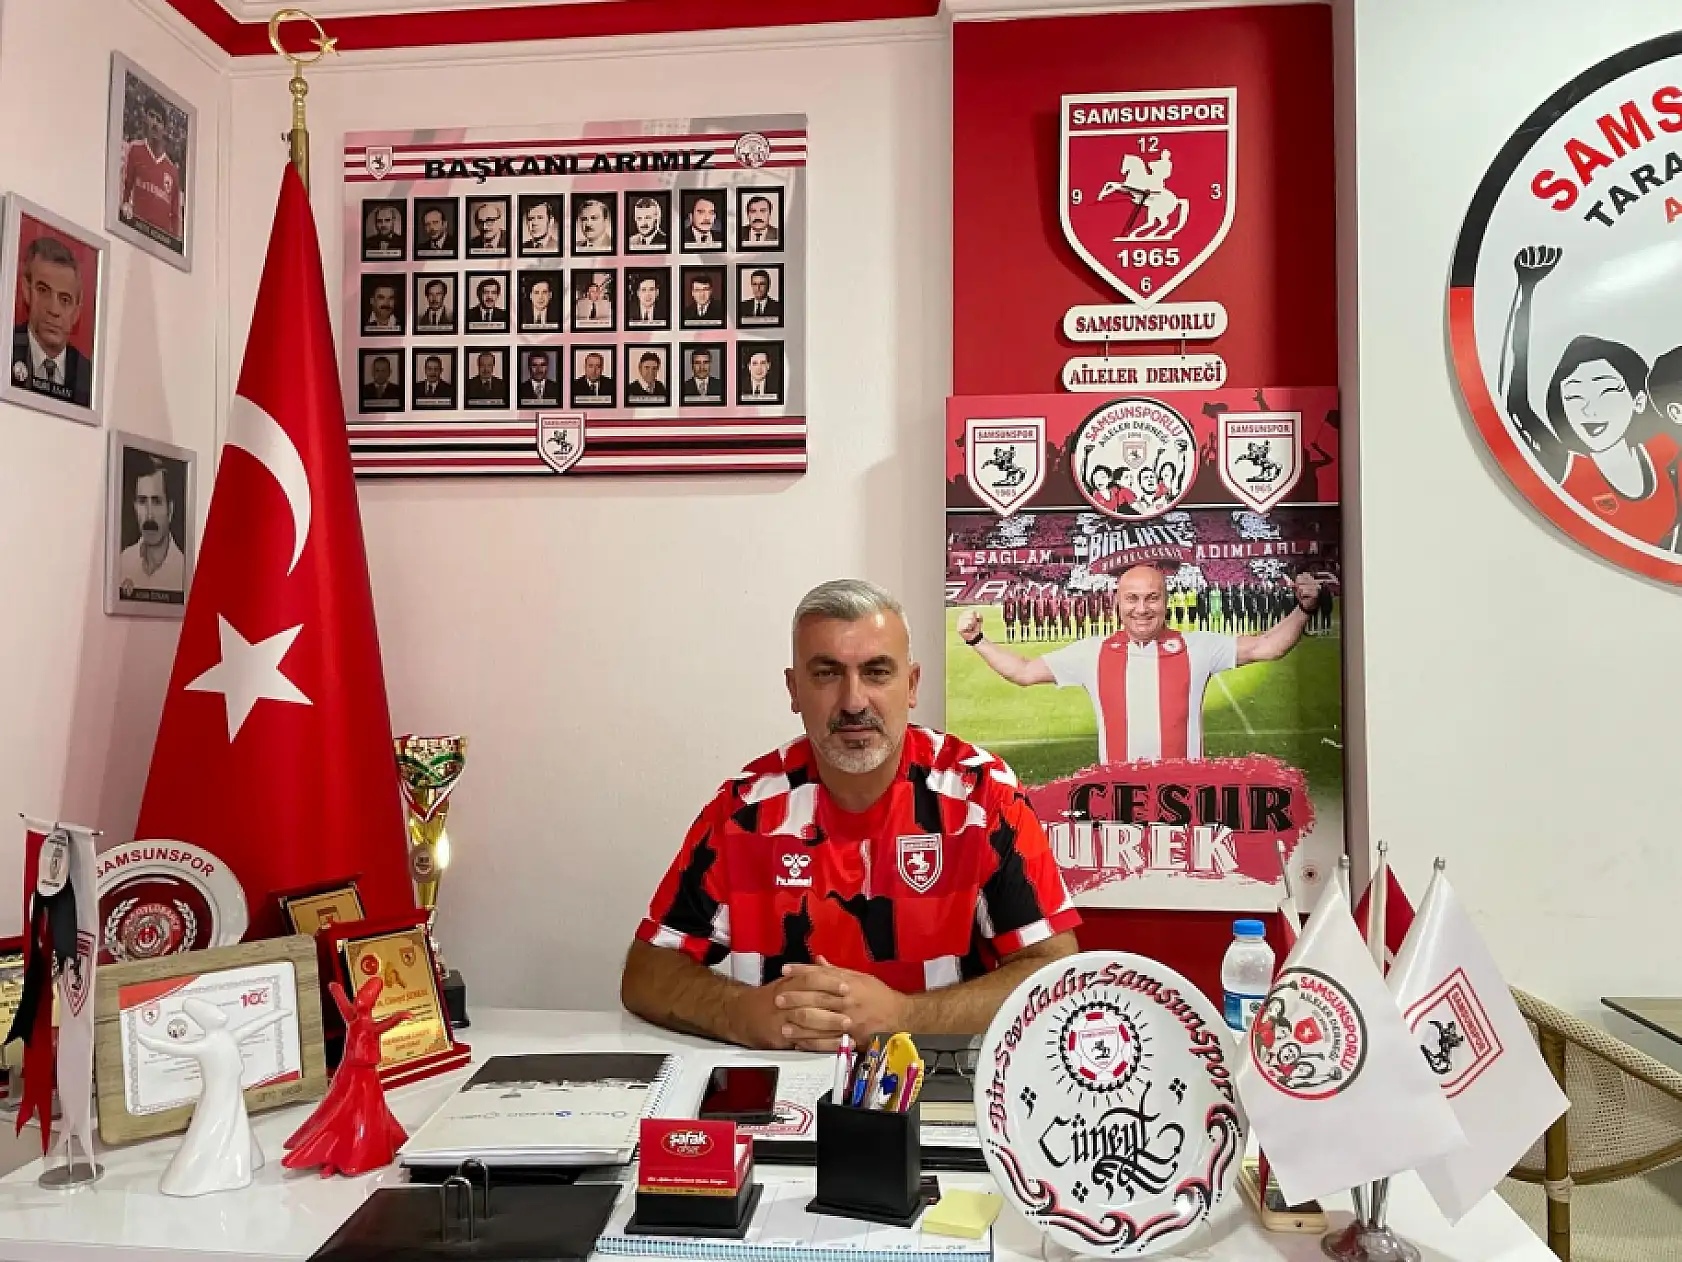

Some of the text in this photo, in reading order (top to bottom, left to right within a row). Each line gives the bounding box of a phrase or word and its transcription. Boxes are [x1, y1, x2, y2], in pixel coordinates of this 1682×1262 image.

[1072, 103, 1225, 125] SAMSUNSPOR
[1137, 136, 1159, 153] 12
[424, 150, 715, 184] BAŞKANLARIMIZ
[1071, 189, 1083, 205] 9
[1210, 183, 1222, 199] 3
[1116, 248, 1181, 268] 1965
[1139, 277, 1151, 293] 6
[1075, 312, 1217, 334] SAMSUNSPORLU
[1069, 360, 1223, 385] AİLELER DERNEĞİ
[1068, 782, 1294, 833] CESUR
